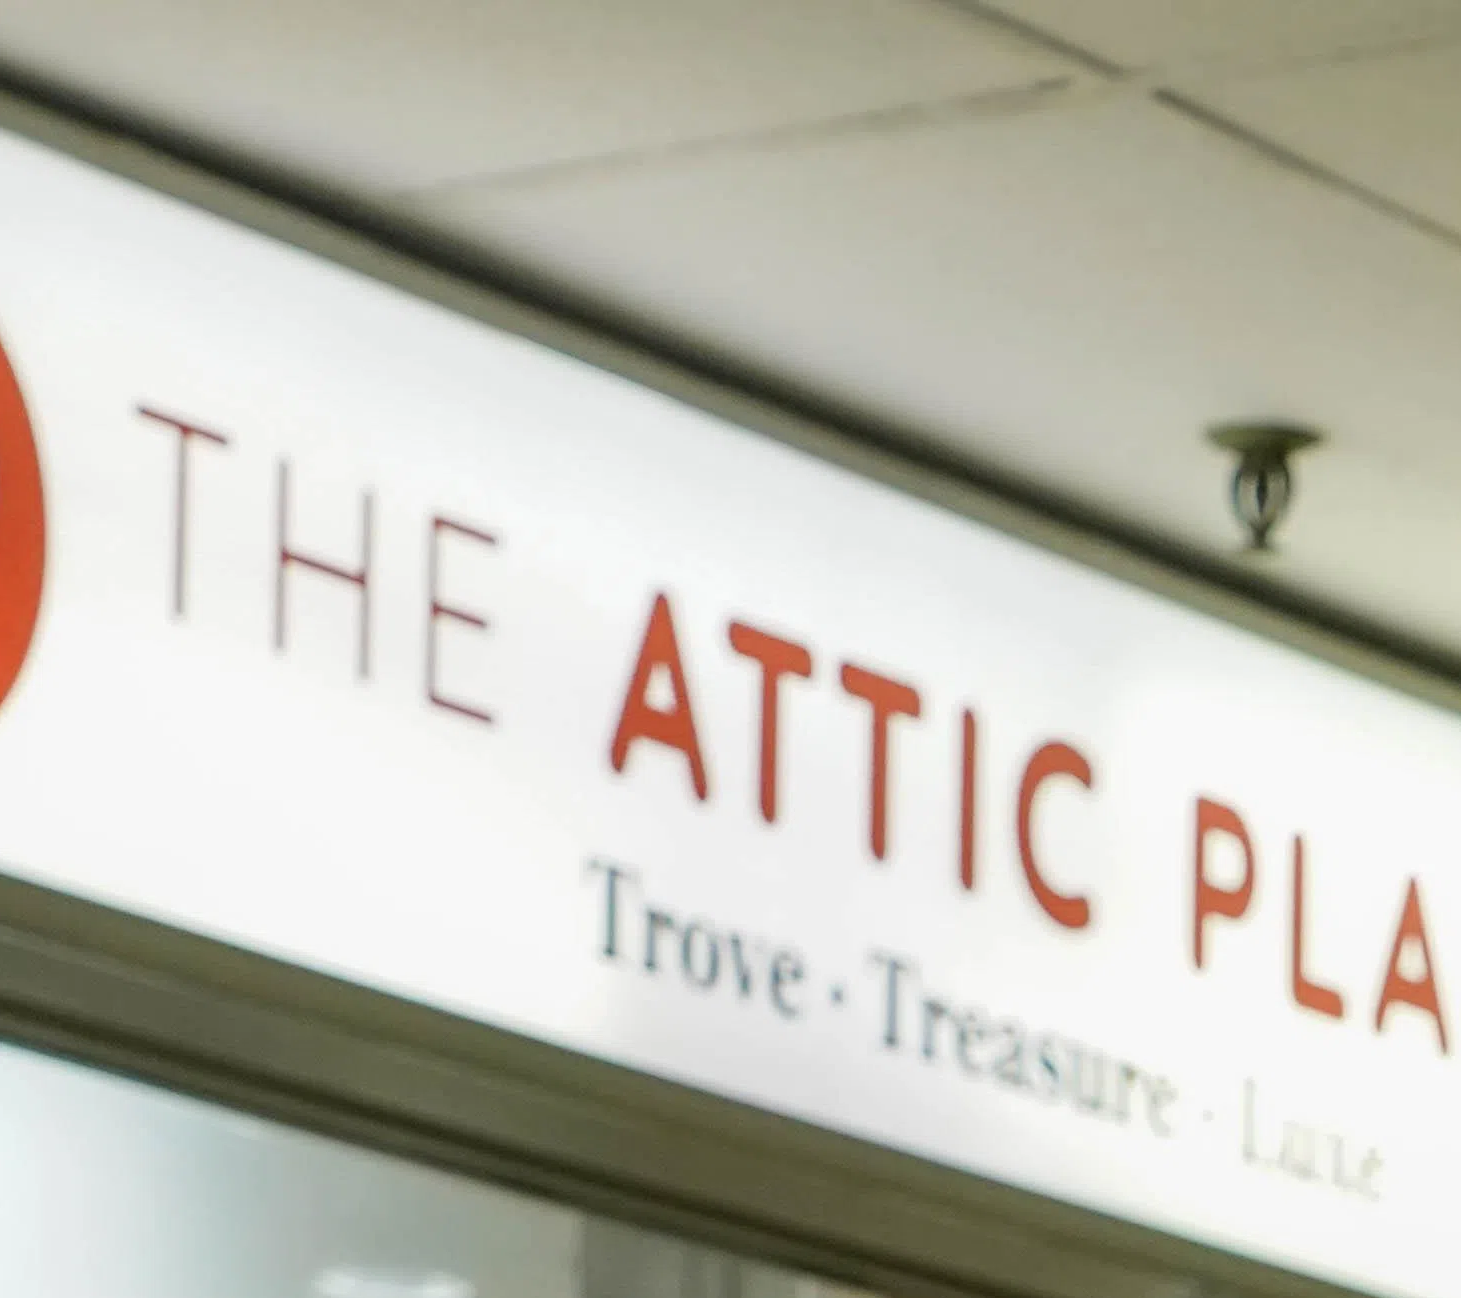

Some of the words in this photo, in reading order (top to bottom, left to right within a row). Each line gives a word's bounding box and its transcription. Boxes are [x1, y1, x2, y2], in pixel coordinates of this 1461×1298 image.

[137, 405, 499, 722] THE
[609, 593, 1096, 932] ATTIC
[587, 857, 807, 1022] Trove
[871, 948, 1177, 1136] Treasure
